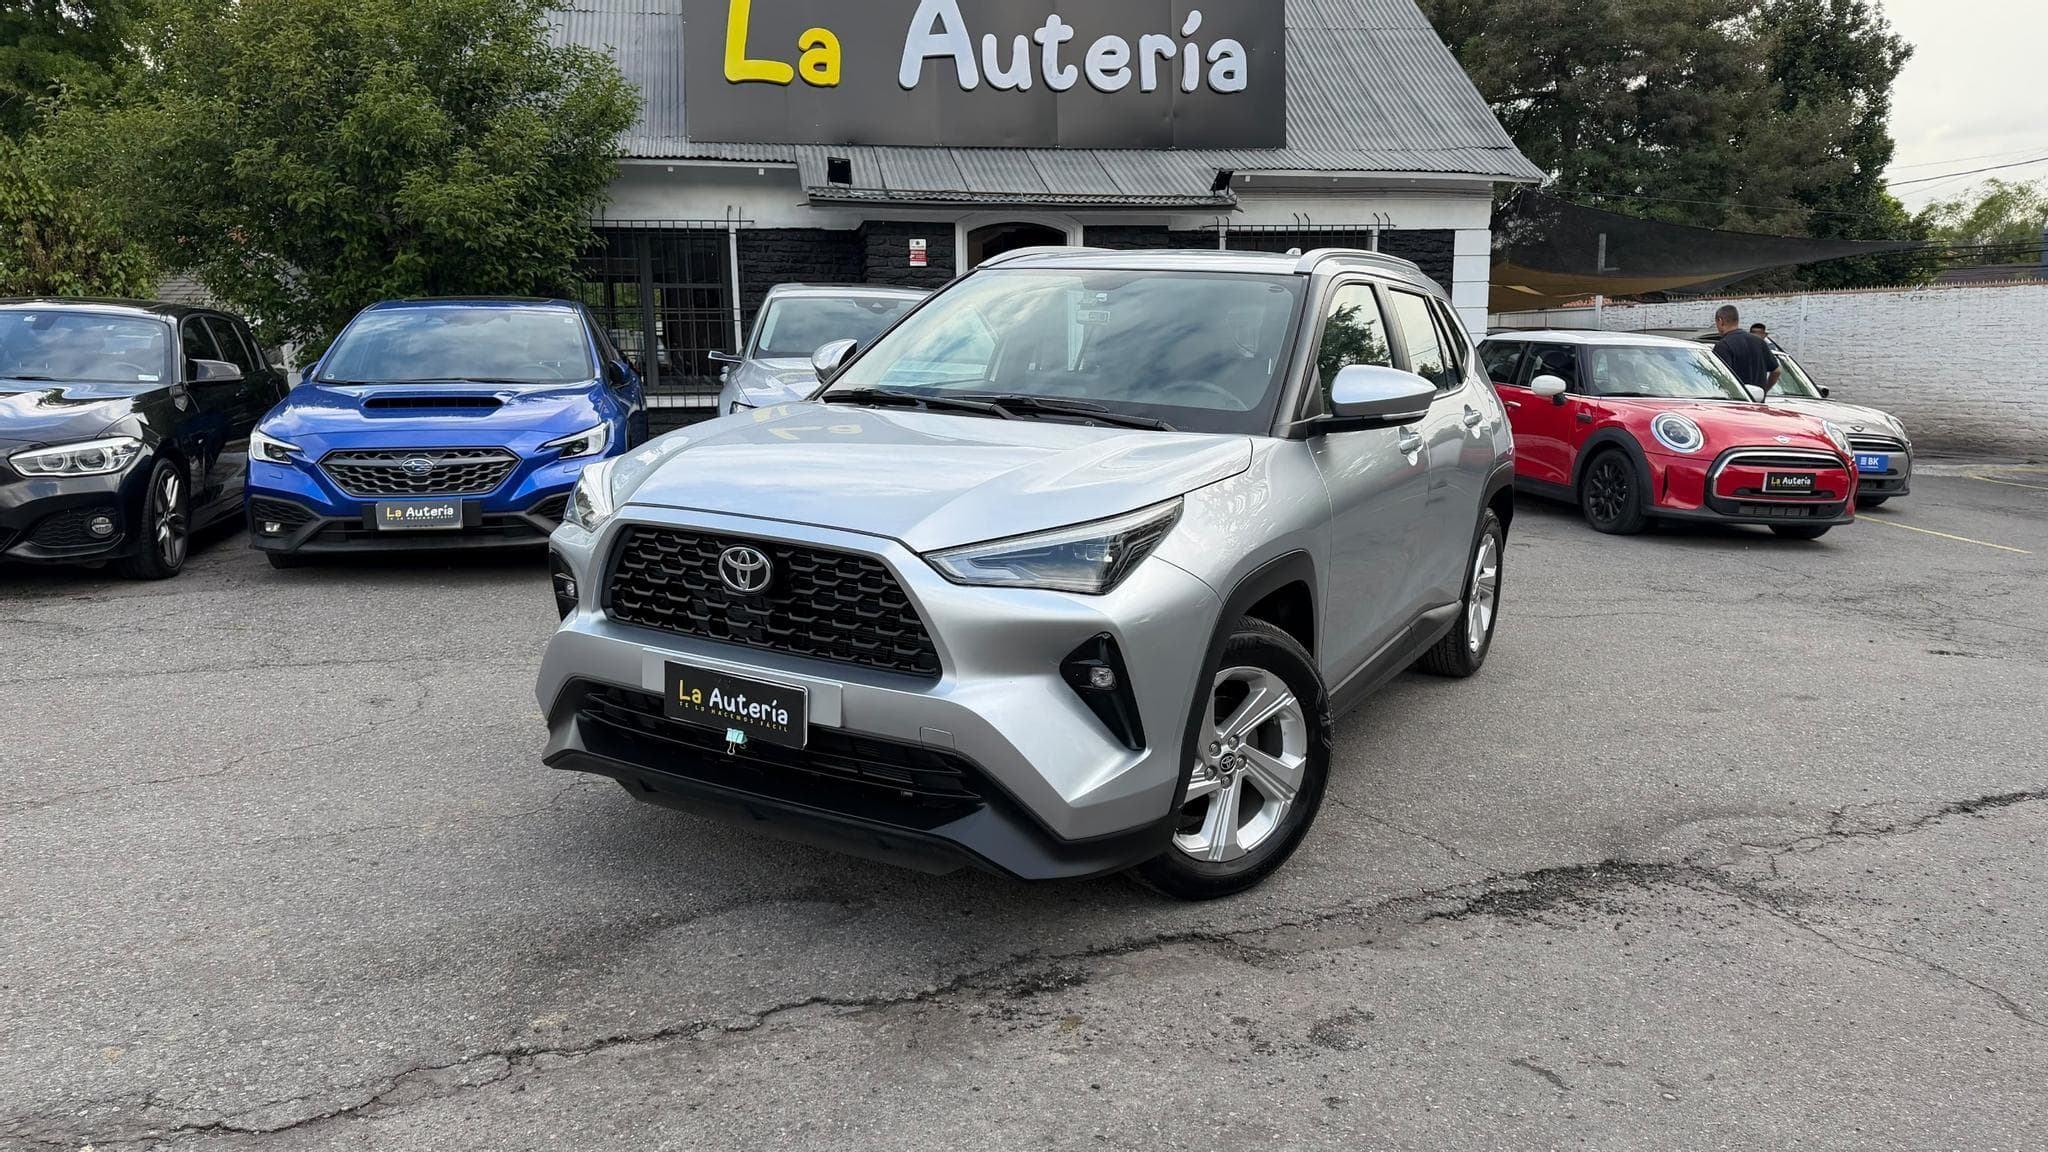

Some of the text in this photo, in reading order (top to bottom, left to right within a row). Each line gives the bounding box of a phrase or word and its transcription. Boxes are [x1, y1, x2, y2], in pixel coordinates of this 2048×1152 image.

[723, 0, 1248, 93] La Autería
[1771, 476, 1781, 485] La
[386, 504, 454, 518] La Autería
[679, 679, 788, 725] La Autería
